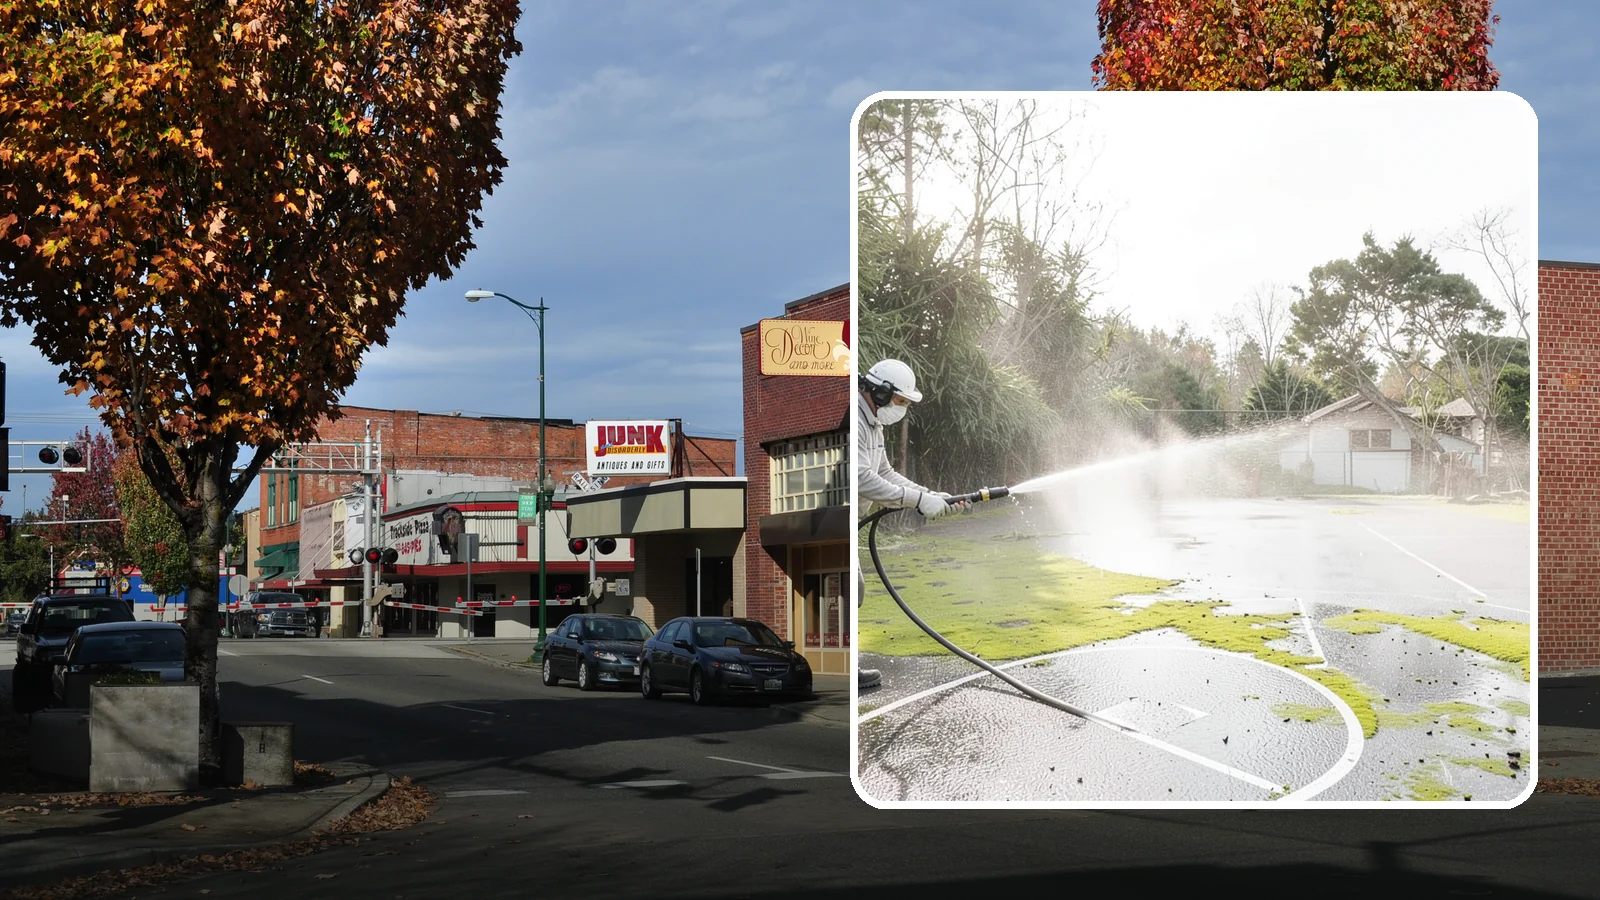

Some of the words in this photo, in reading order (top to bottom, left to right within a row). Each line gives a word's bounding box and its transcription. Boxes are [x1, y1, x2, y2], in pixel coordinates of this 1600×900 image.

[596, 425, 665, 457] JUNK
[607, 446, 646, 454] DISORDERLY
[597, 461, 628, 470] ANTIQUES
[631, 461, 644, 470] AND
[647, 460, 665, 470] GIFTS
[390, 521, 413, 540] Trackside
[414, 519, 430, 535] Pizza
